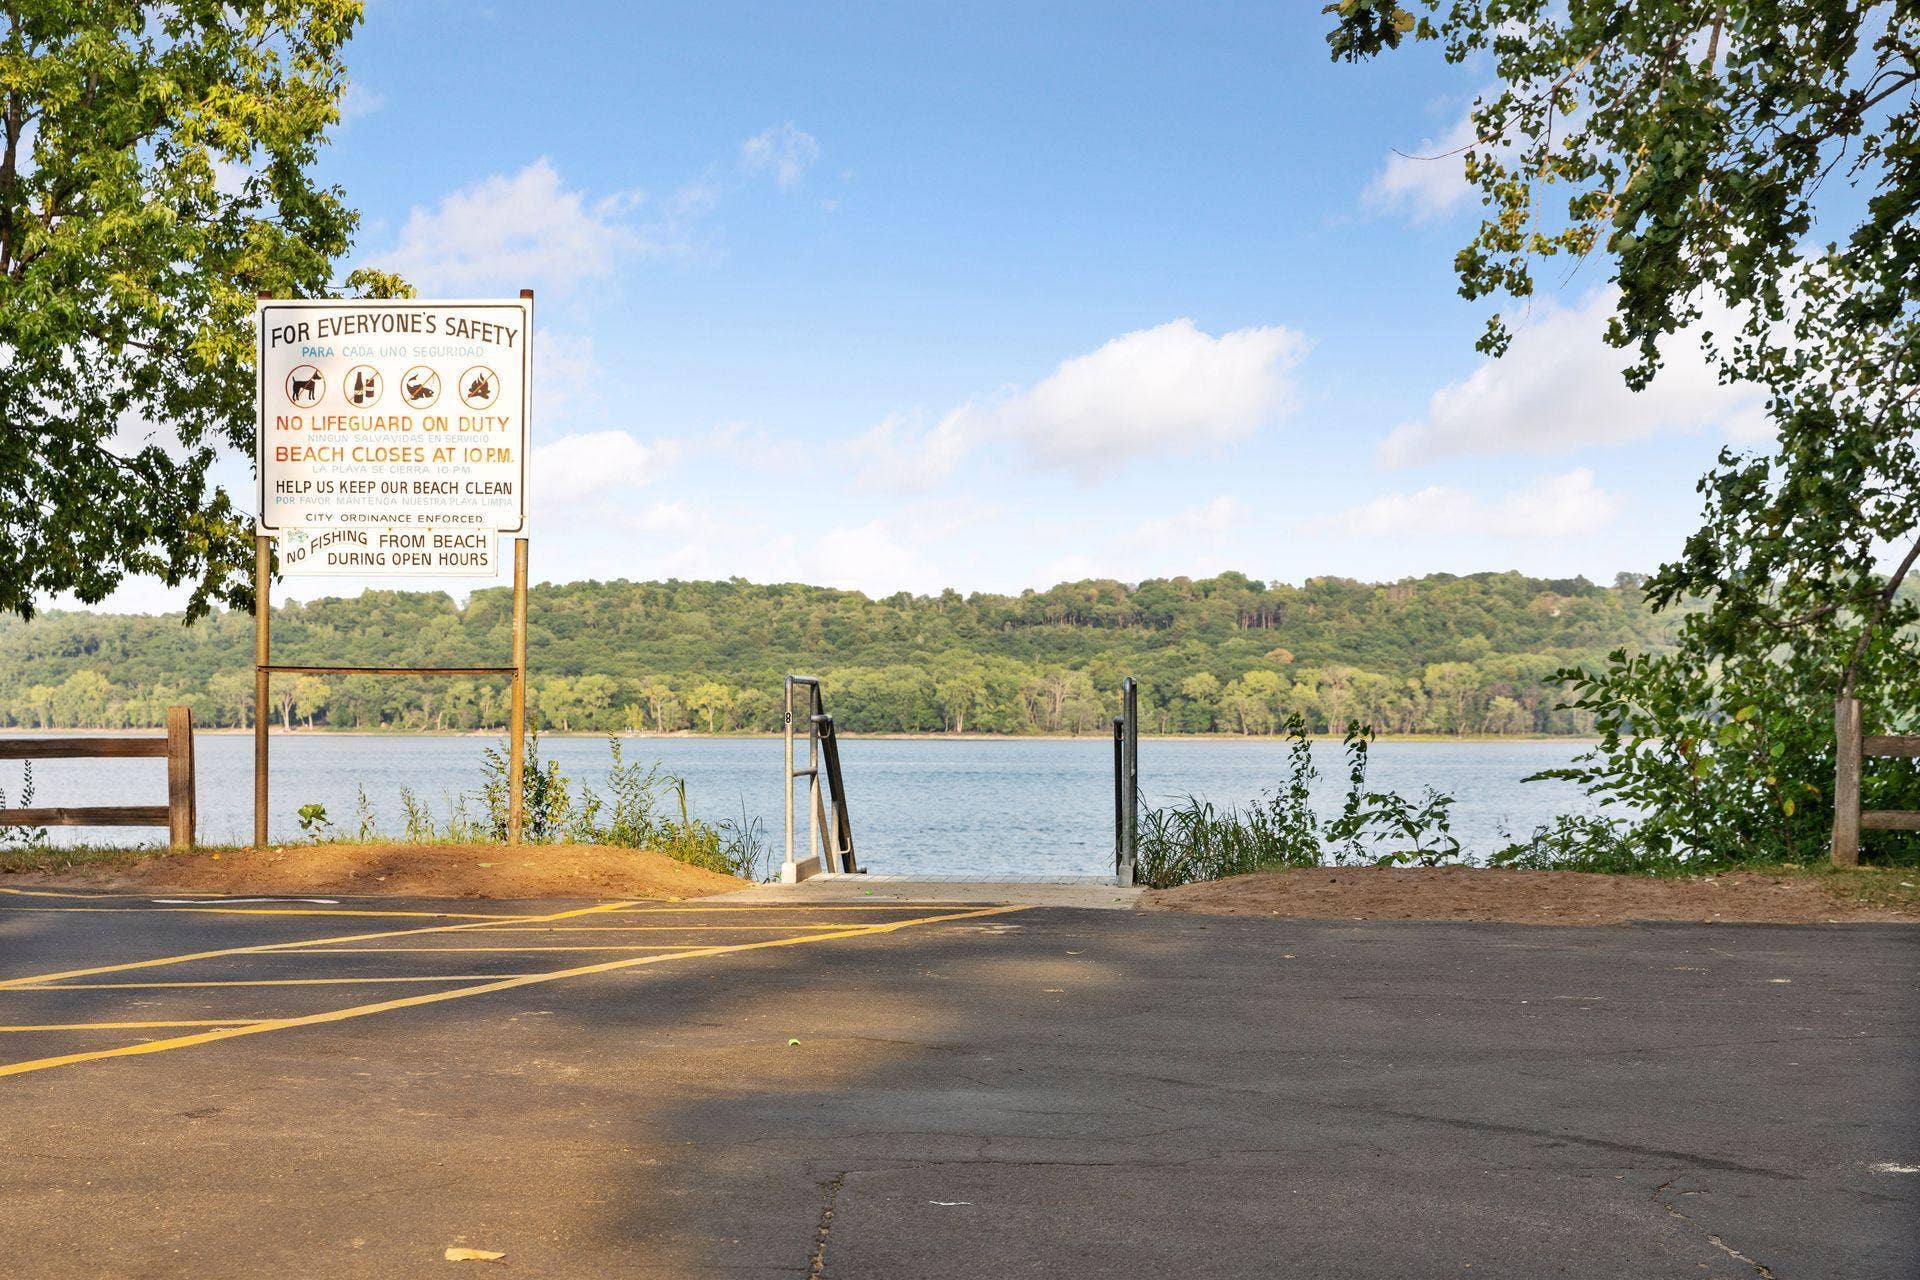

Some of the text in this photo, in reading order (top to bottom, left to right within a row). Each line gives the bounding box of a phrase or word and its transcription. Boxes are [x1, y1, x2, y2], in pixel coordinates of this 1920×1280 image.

[271, 312, 518, 348] FOR EVERYONE'S SAFETY
[302, 346, 484, 357] PARA CADA UNO SEGURIDAD
[277, 416, 510, 432] NO LIFEGUARD ON DUTY
[307, 434, 349, 443] NINGUN
[355, 434, 423, 443] SALVAVIDAS
[429, 434, 442, 443] EN
[276, 447, 514, 463] BEACH CLOSES AT 10 P.M.
[312, 465, 326, 474] LA
[332, 466, 367, 474] PLAYA
[372, 466, 384, 474] SE
[389, 466, 430, 474] CIERRA
[437, 466, 448, 474] 10
[276, 481, 512, 495] HELP US KEEP OUR BEACH CLEAN
[276, 496, 513, 506] POR FAVOR MANTENGA NUESTRA PLAYA LIMPIA
[306, 513, 483, 523] CITY ORDINANCE ENFORCED
[287, 530, 486, 564] NO FISHING FROM BEACH
[328, 553, 488, 566] DURING OPEN HOURS
[786, 713, 791, 723] 8
